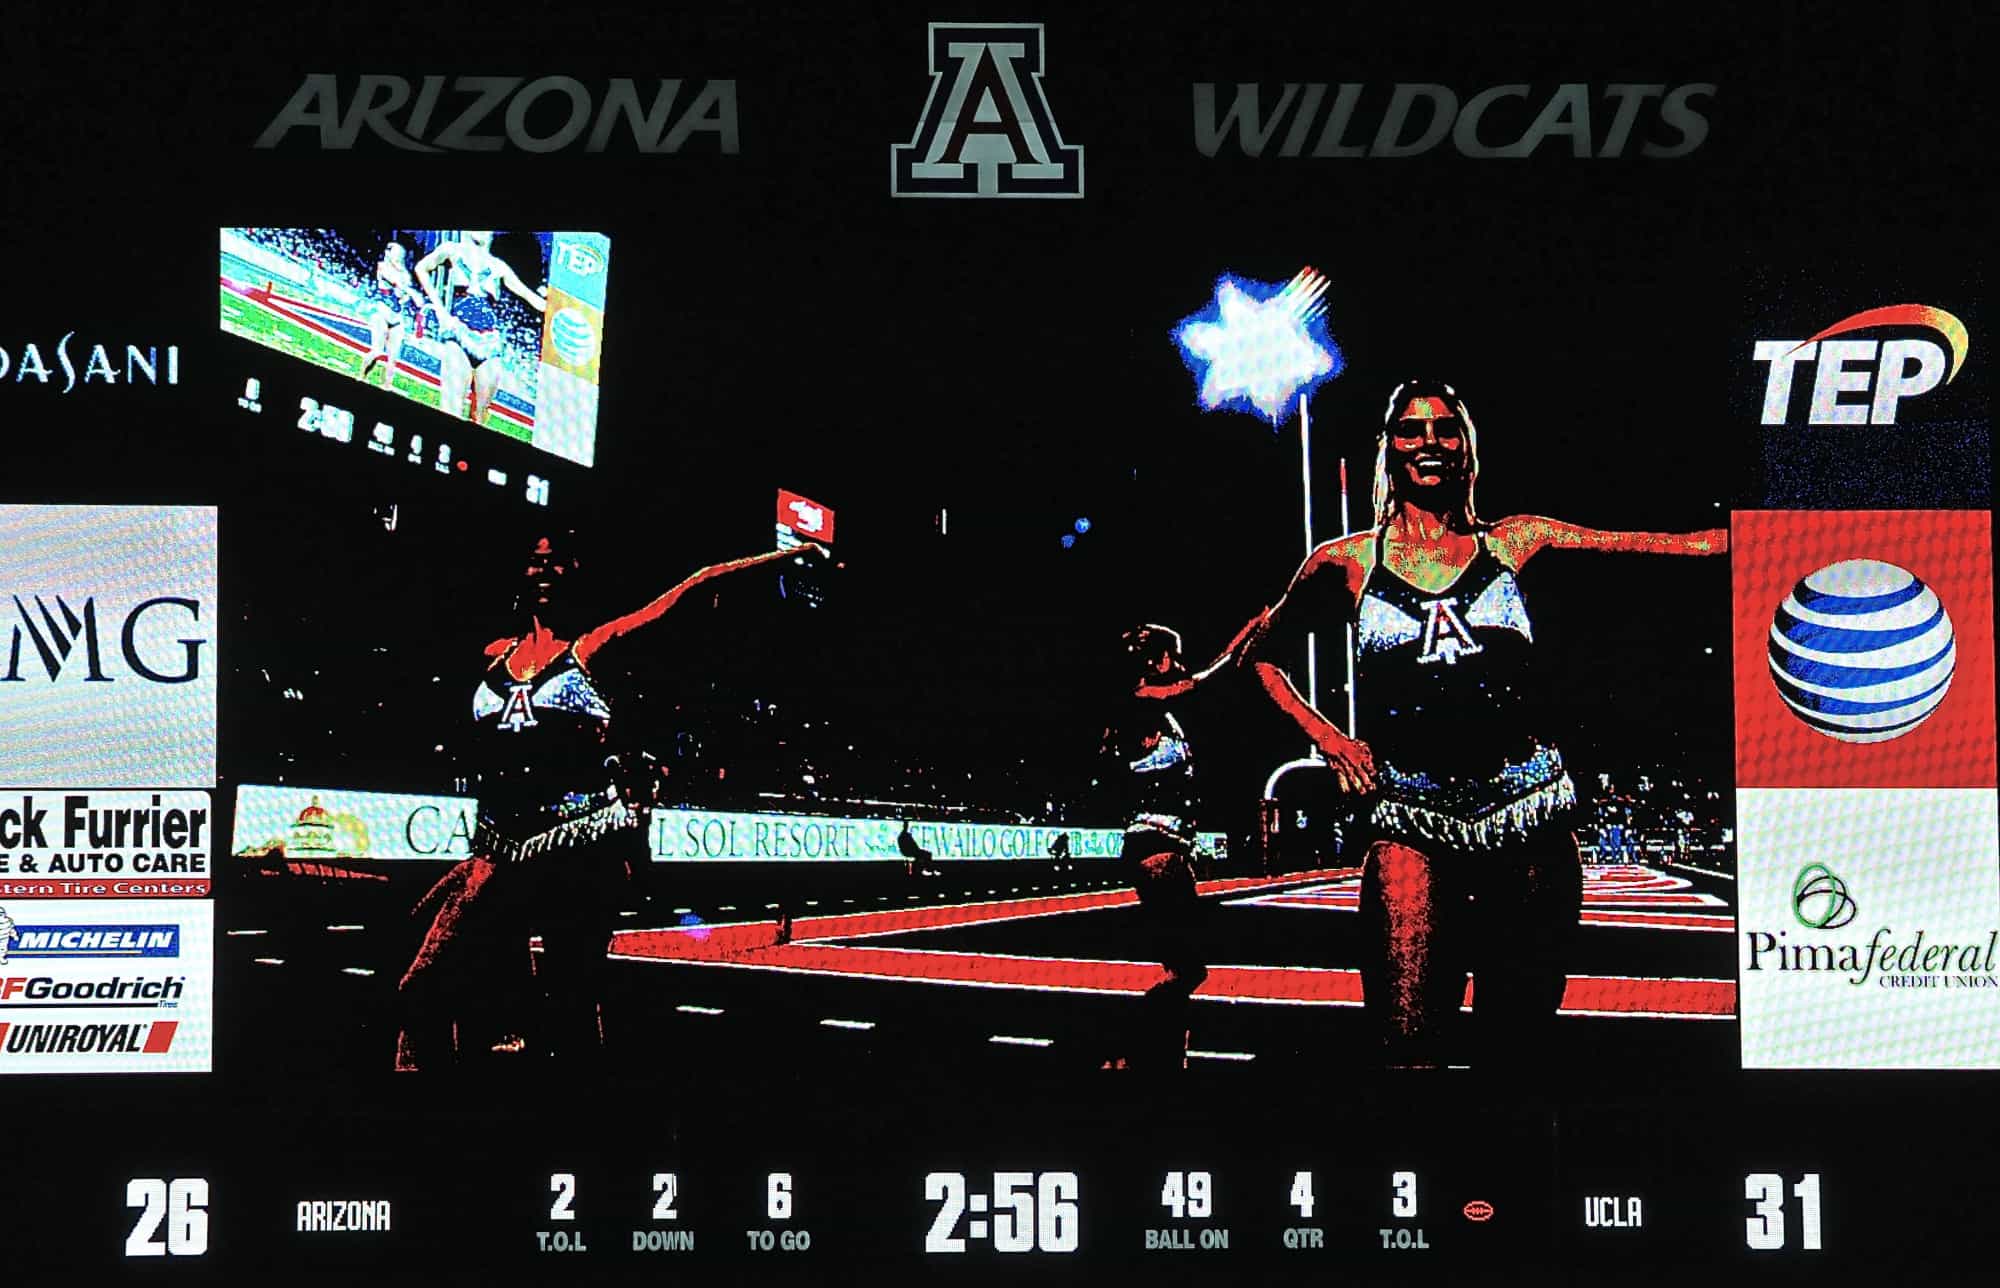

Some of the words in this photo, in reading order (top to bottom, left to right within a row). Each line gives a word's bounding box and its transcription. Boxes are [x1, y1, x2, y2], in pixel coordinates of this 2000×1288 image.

[253, 73, 740, 154] ARIZONA
[891, 20, 1085, 199] A
[1192, 82, 1716, 158] WILDCATS
[1753, 339, 1946, 425] TEP
[64, 794, 207, 849] Furrier
[684, 818, 744, 858] SOL
[755, 821, 855, 858] RESORT
[48, 853, 124, 873] AUTO
[132, 853, 206, 873] CARE
[0, 883, 54, 894] tern
[59, 882, 107, 894] Tire
[113, 882, 206, 894] Centers
[18, 931, 174, 949] MICHELIN
[0, 976, 184, 1000] FGoodrich
[1879, 975, 1939, 988] CREDIT
[1944, 975, 1999, 988] UNION
[6, 1023, 141, 1054] UNIROYAL
[550, 1173, 576, 1220] 2
[652, 1173, 678, 1220] 2
[767, 1172, 793, 1220] 6
[1160, 1171, 1213, 1218] 49
[1289, 1171, 1315, 1218] 4
[1392, 1171, 1418, 1218] 3
[125, 1178, 209, 1257] 26
[297, 1200, 391, 1232] ARIZONA
[924, 1171, 1079, 1253] 2:56
[1584, 1196, 1643, 1228] UCLA
[1744, 1173, 1822, 1250] 31
[536, 1231, 587, 1252] T.O.L
[632, 1230, 695, 1252] DOWN
[746, 1230, 775, 1251] TO
[780, 1230, 811, 1251] GO
[1145, 1228, 1196, 1250] BALL
[1200, 1228, 1229, 1250] ON
[1283, 1228, 1324, 1250] QTR
[1379, 1228, 1430, 1250] T.O.L
